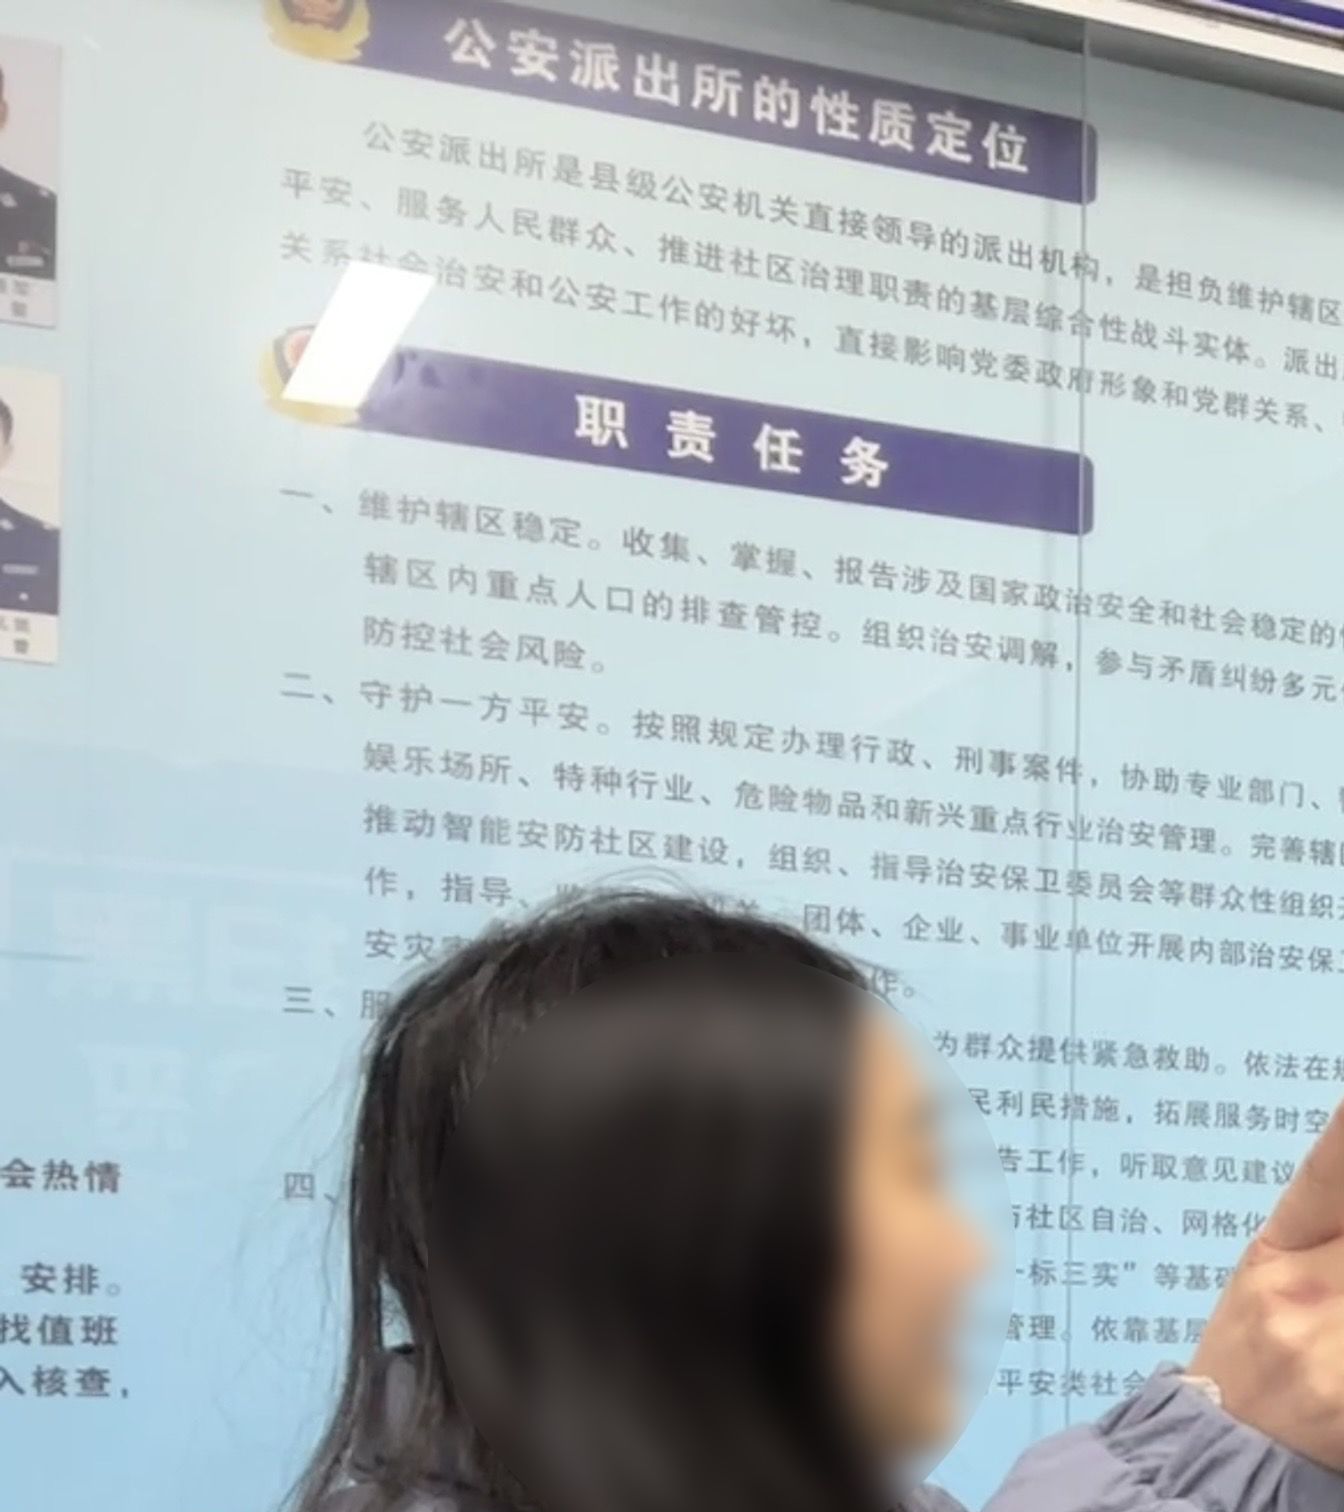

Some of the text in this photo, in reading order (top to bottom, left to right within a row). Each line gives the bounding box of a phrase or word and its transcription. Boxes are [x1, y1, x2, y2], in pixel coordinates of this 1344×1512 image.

[444, 18, 1032, 174] 公安派出所的性质定位
[575, 394, 890, 490] 职责任务
[364, 615, 609, 673] 防控社会风险。
[0, 1157, 122, 1194] 会热情
